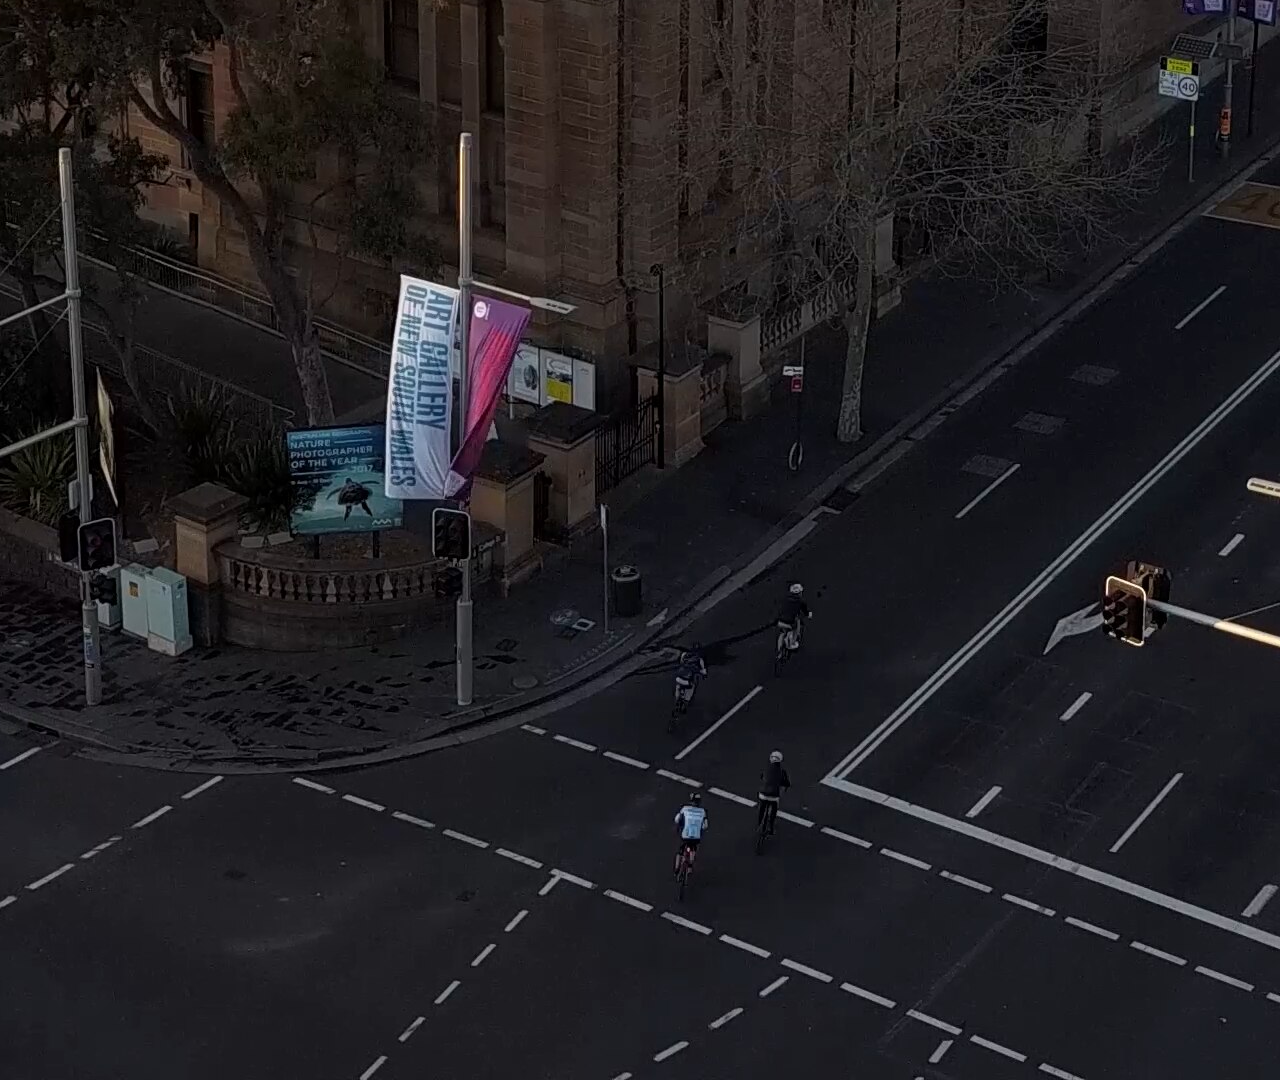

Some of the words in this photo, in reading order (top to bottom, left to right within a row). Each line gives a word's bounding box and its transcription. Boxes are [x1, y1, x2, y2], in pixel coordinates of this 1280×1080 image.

[1182, 82, 1195, 92] 40
[404, 283, 428, 315] OF
[423, 289, 455, 337] ART
[397, 315, 422, 360] NEW
[415, 339, 449, 430] GALLERY
[289, 439, 331, 449] NATURE
[289, 445, 374, 459] PHOTOGRAPHER
[290, 460, 306, 469] OF
[307, 458, 328, 468] THE
[330, 457, 358, 466] YEAR
[389, 425, 417, 488] WALES
[350, 464, 374, 473] 2017
